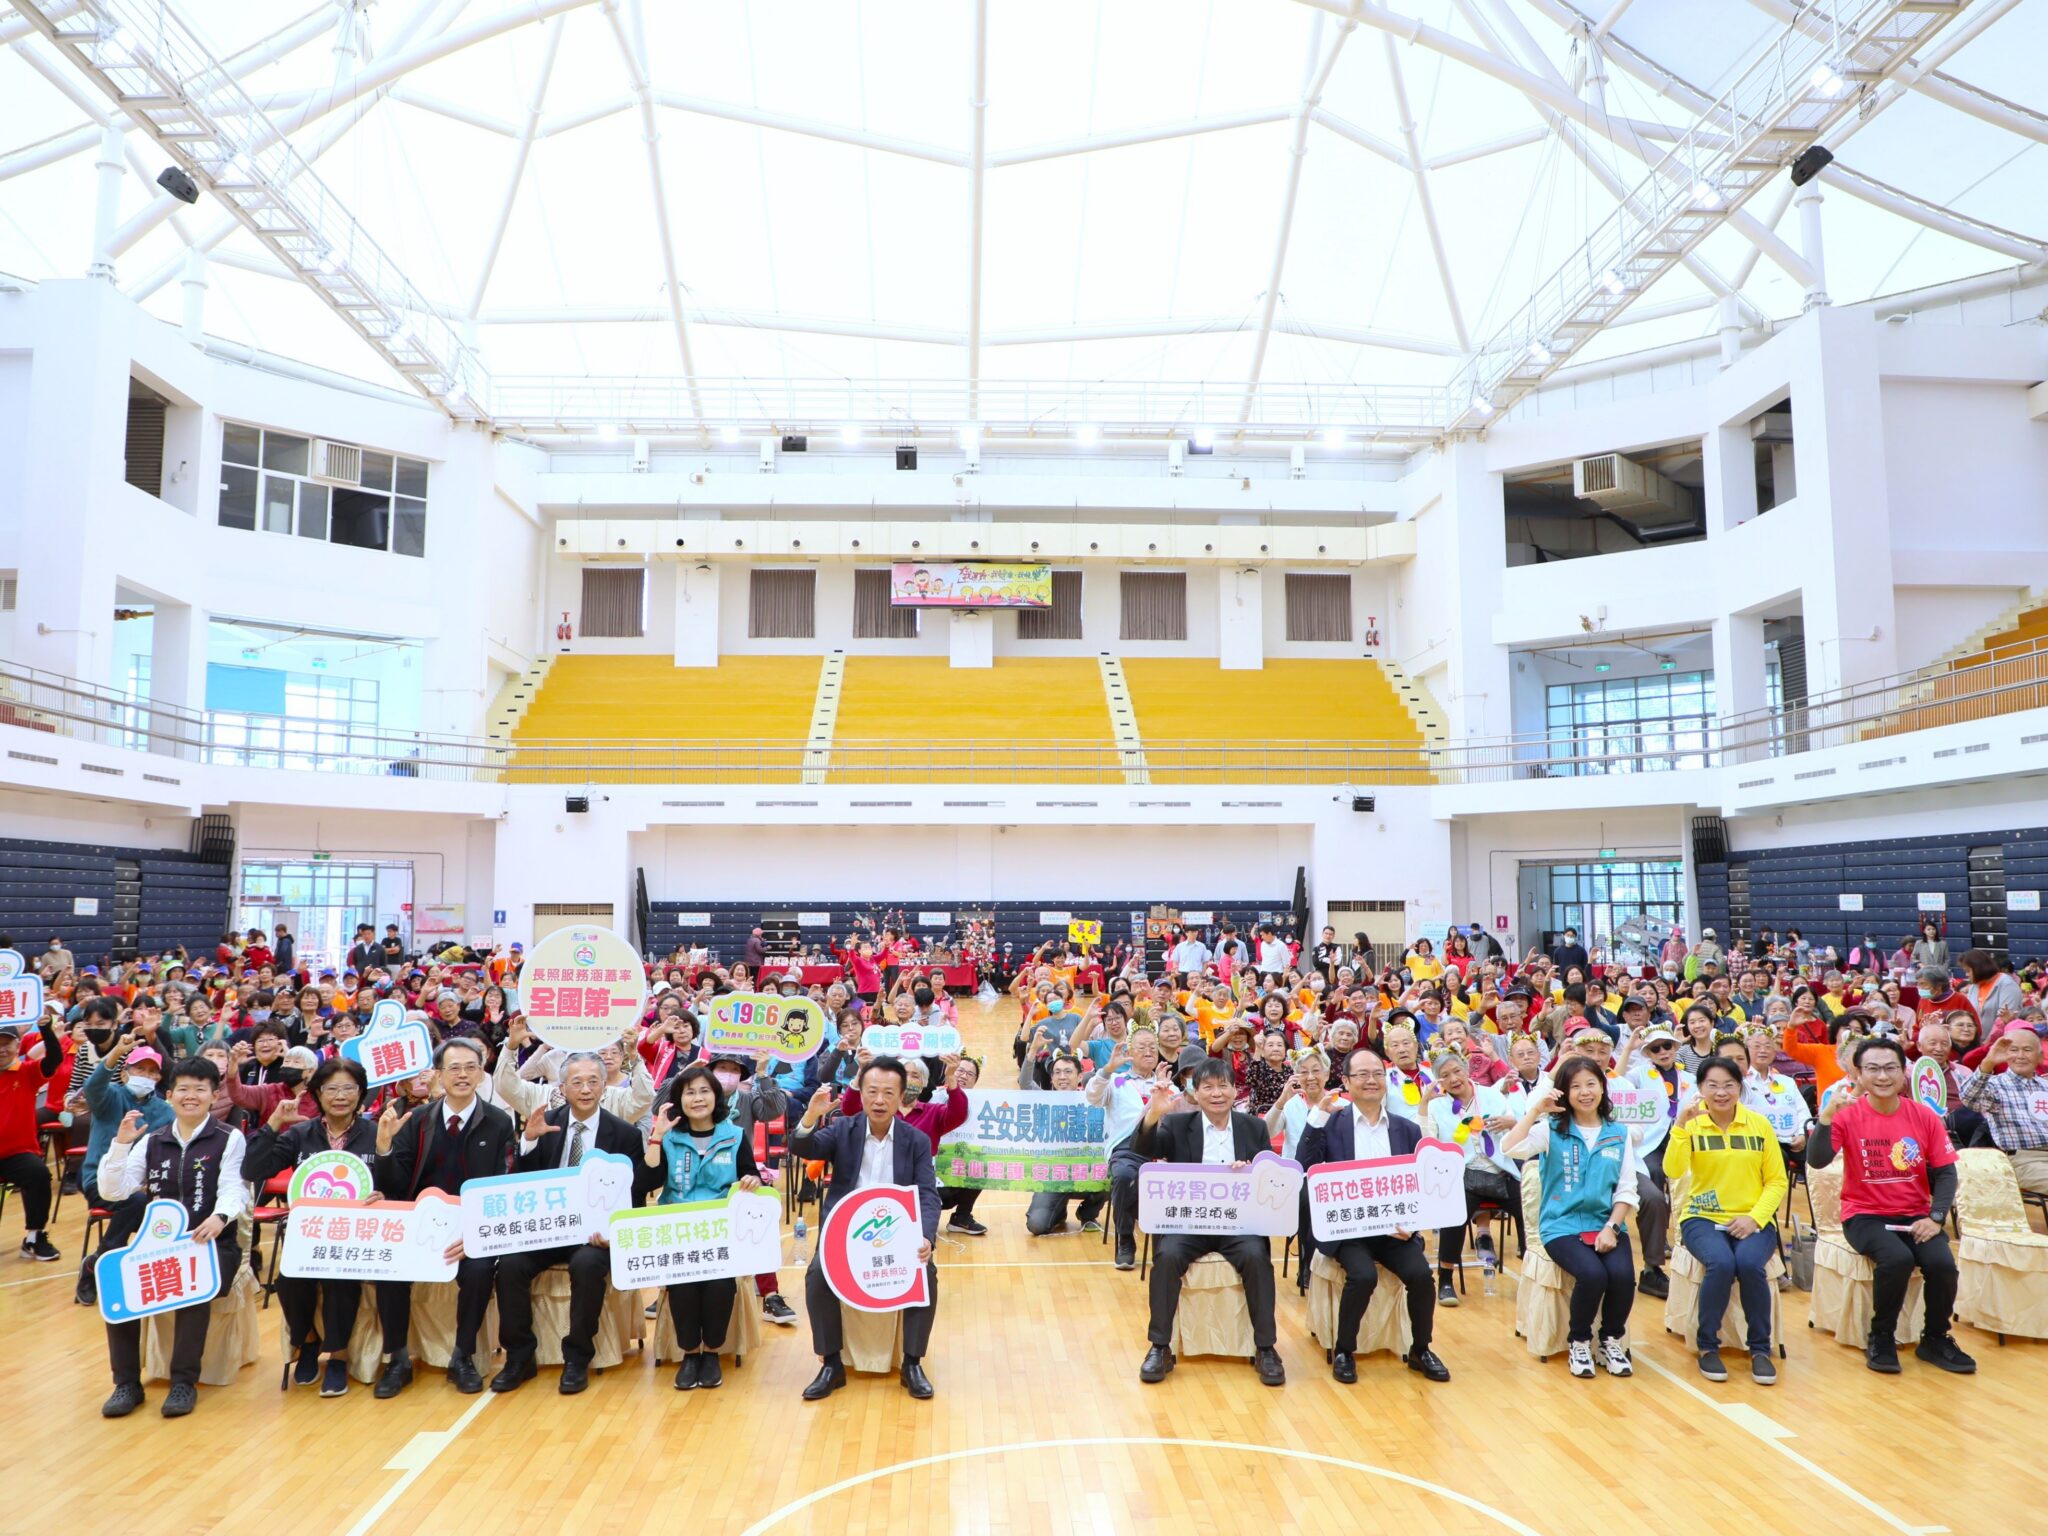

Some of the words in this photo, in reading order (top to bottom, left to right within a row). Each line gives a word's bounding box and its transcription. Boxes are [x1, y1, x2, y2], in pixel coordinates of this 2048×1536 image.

[532, 968, 632, 982] 長照服務涵蓋率
[529, 987, 637, 1018] 全國第一
[732, 1002, 779, 1026] 1966
[868, 1032, 899, 1049] 電話
[923, 1032, 956, 1049] 關懷
[371, 1040, 417, 1077] 讚!
[1611, 1093, 1637, 1104] 健康
[977, 1100, 1109, 1143] 全安長期照護體
[1860, 1138, 1891, 1147] TAIWAN
[1861, 1149, 1883, 1157] ORAL
[951, 1158, 1025, 1180] 全心照護
[1863, 1159, 1884, 1168] CARE
[1147, 1180, 1251, 1201] 牙好胃口好
[1314, 1172, 1420, 1203] 假牙也要好好刷
[483, 1186, 568, 1218] 顧好牙
[1165, 1206, 1238, 1220] 健康沒煩惱
[1327, 1201, 1419, 1223] 細菌遠離不擔心
[300, 1216, 406, 1243] 從齒開始
[479, 1213, 582, 1238] 早晚飯後記得刷
[617, 1218, 729, 1251] 學會潔牙技巧
[312, 1246, 393, 1262] 銀髮好生活
[872, 1254, 895, 1268] 醫事
[138, 1256, 197, 1305] 讚!
